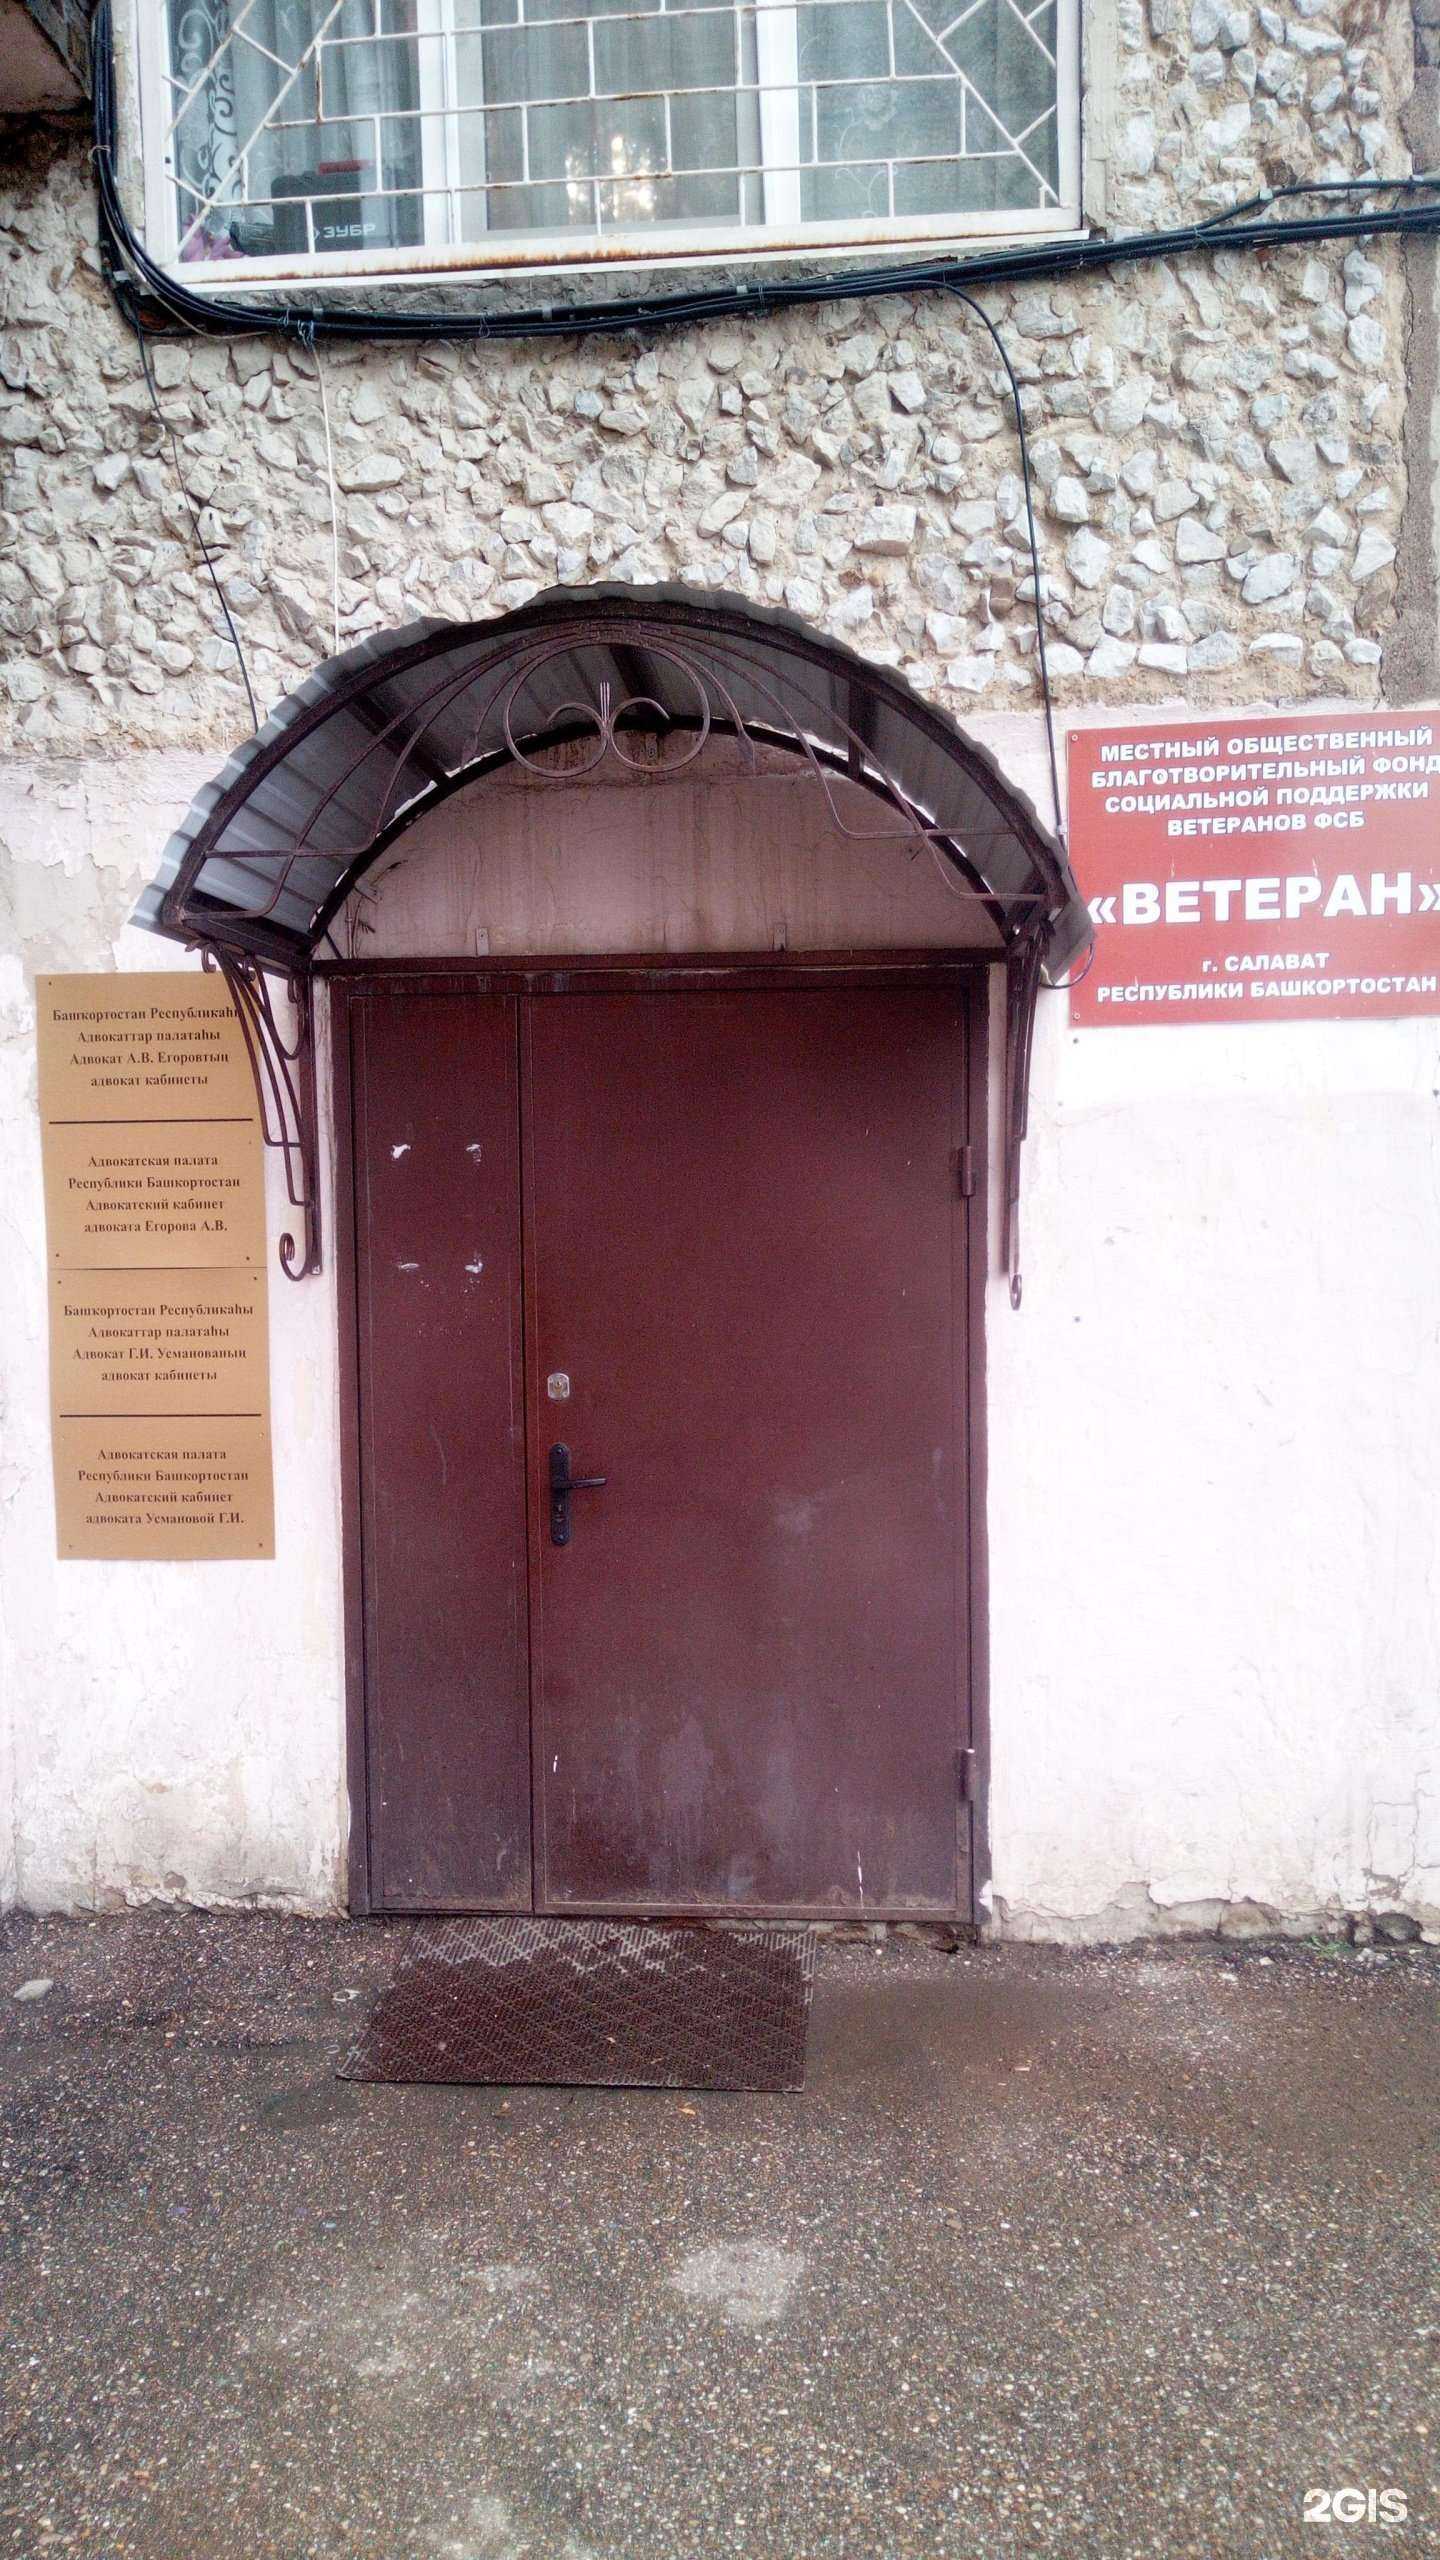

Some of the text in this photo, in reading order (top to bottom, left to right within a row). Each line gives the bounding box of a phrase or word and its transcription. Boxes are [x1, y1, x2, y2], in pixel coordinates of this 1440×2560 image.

[323, 224, 376, 238] ЗУБР
[1101, 727, 1432, 761] МЕСТНЫЙ ОБЩЕСТВЕННЫЙ
[1091, 756, 1440, 787] БЛАГОТВОРИТЕЛЬНЫЙ ФОНД
[1105, 783, 1428, 814] СОЦИАЛЬНОЙ ПОДДЕРЖКИ
[1168, 811, 1364, 836] ВЕТЕРАНОВ ФСБ
[1087, 872, 1440, 925] «ВЕТЕРАН»
[1202, 953, 1329, 972] г. САЛАВАТ
[1097, 977, 1436, 1002] РЕСПУБЛИКИ БАШКОРТОСТАН
[77, 1031, 152, 1044] Адвокаттар
[70, 1053, 122, 1065] Адвокат
[126, 1052, 153, 1063] А.В.
[91, 1074, 208, 1086] адвокат кабинеты
[88, 1156, 218, 1167] Адвокатская палата
[69, 1177, 240, 1191] Республики Башкортостан
[86, 1198, 224, 1211] Адвокатский кабинет
[84, 1220, 228, 1233] адвоката Егорова А.В.
[88, 1327, 161, 1339] Адвокаттар
[73, 1349, 124, 1360] Адвокат
[128, 1348, 153, 1359] Г.И.
[102, 1370, 217, 1381] адвокат кабинеты
[98, 1449, 226, 1460] Адвокатская палата
[78, 1470, 248, 1483] Республики Башкортостан
[95, 1491, 233, 1503] Адвокатский кабинет
[86, 1512, 244, 1524] адвоката Усмановой Г.И.
